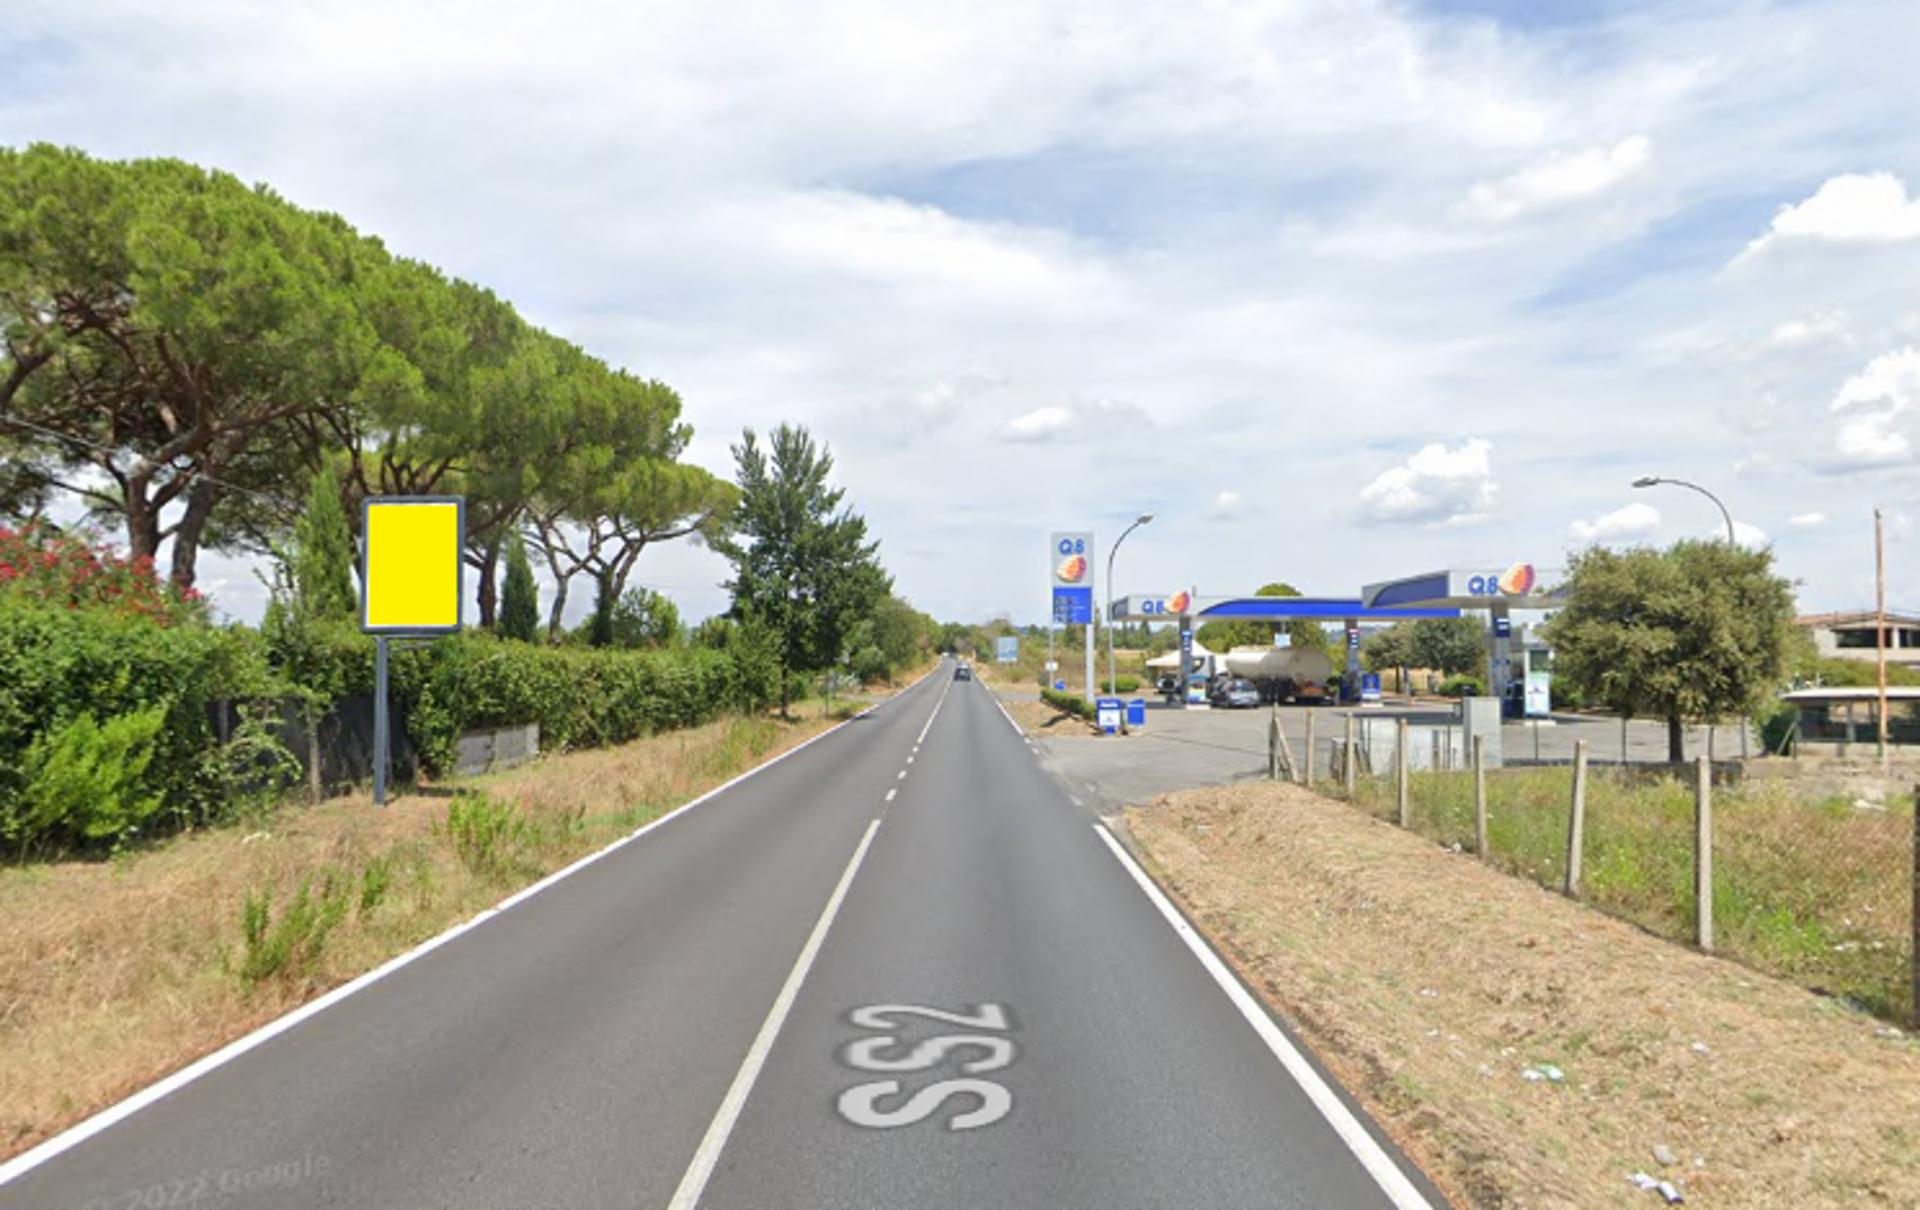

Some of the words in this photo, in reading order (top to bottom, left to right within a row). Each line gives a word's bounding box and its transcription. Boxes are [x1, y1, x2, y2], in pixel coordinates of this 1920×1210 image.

[1058, 538, 1085, 554] Q8
[1467, 575, 1498, 594] Q8
[1142, 600, 1165, 614] Q8
